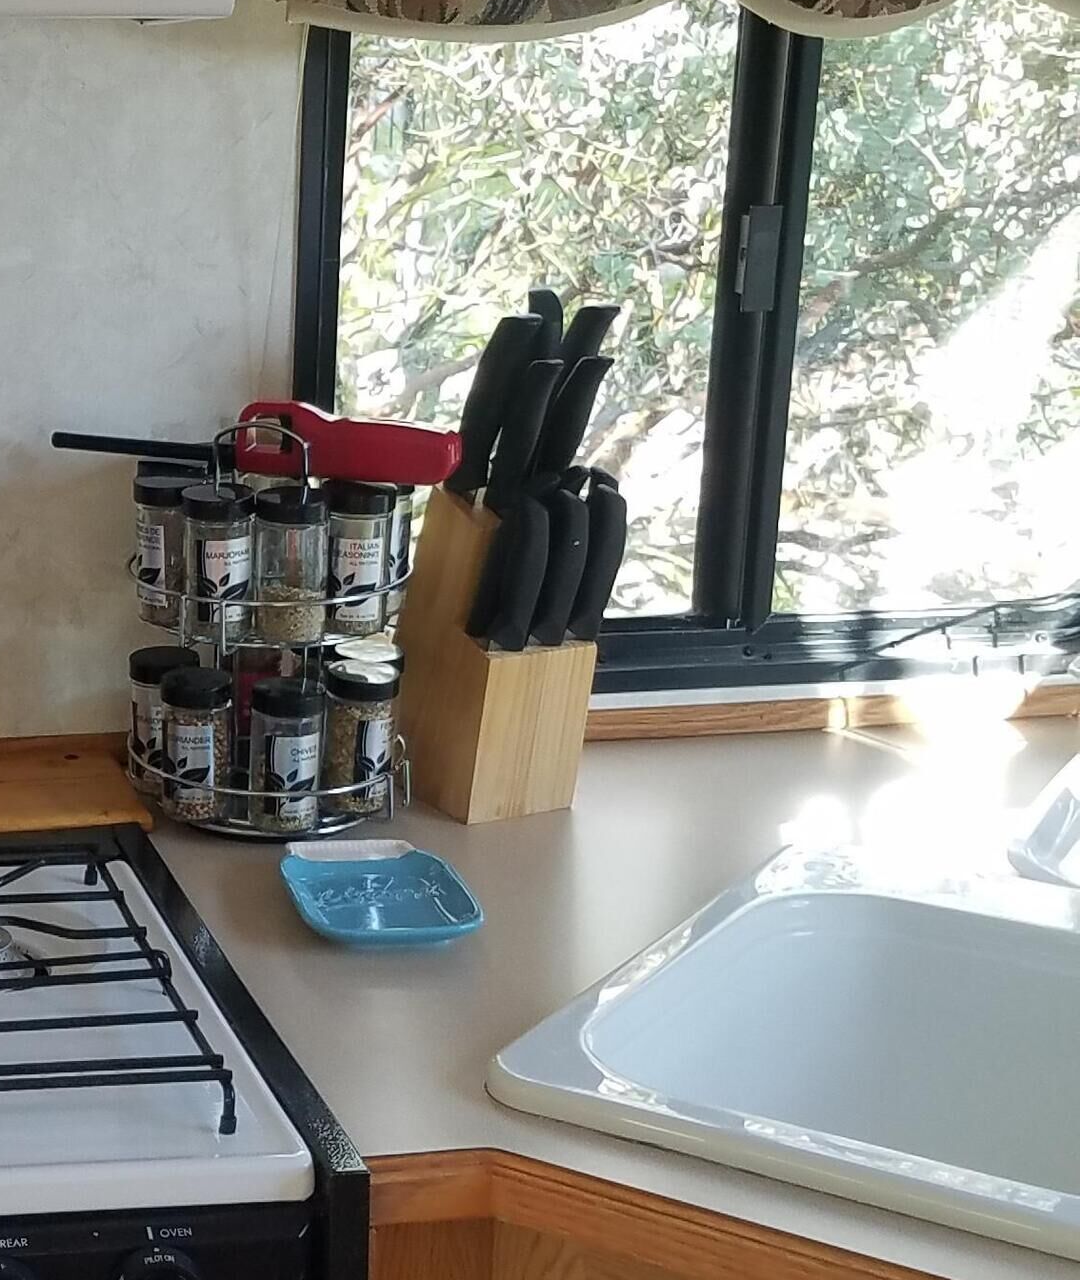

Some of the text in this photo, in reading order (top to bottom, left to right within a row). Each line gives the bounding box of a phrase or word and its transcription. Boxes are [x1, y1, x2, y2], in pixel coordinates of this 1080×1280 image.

[206, 547, 250, 560] MARJORAM
[160, 1227, 193, 1238] OVEN
[0, 1237, 29, 1249] REAR
